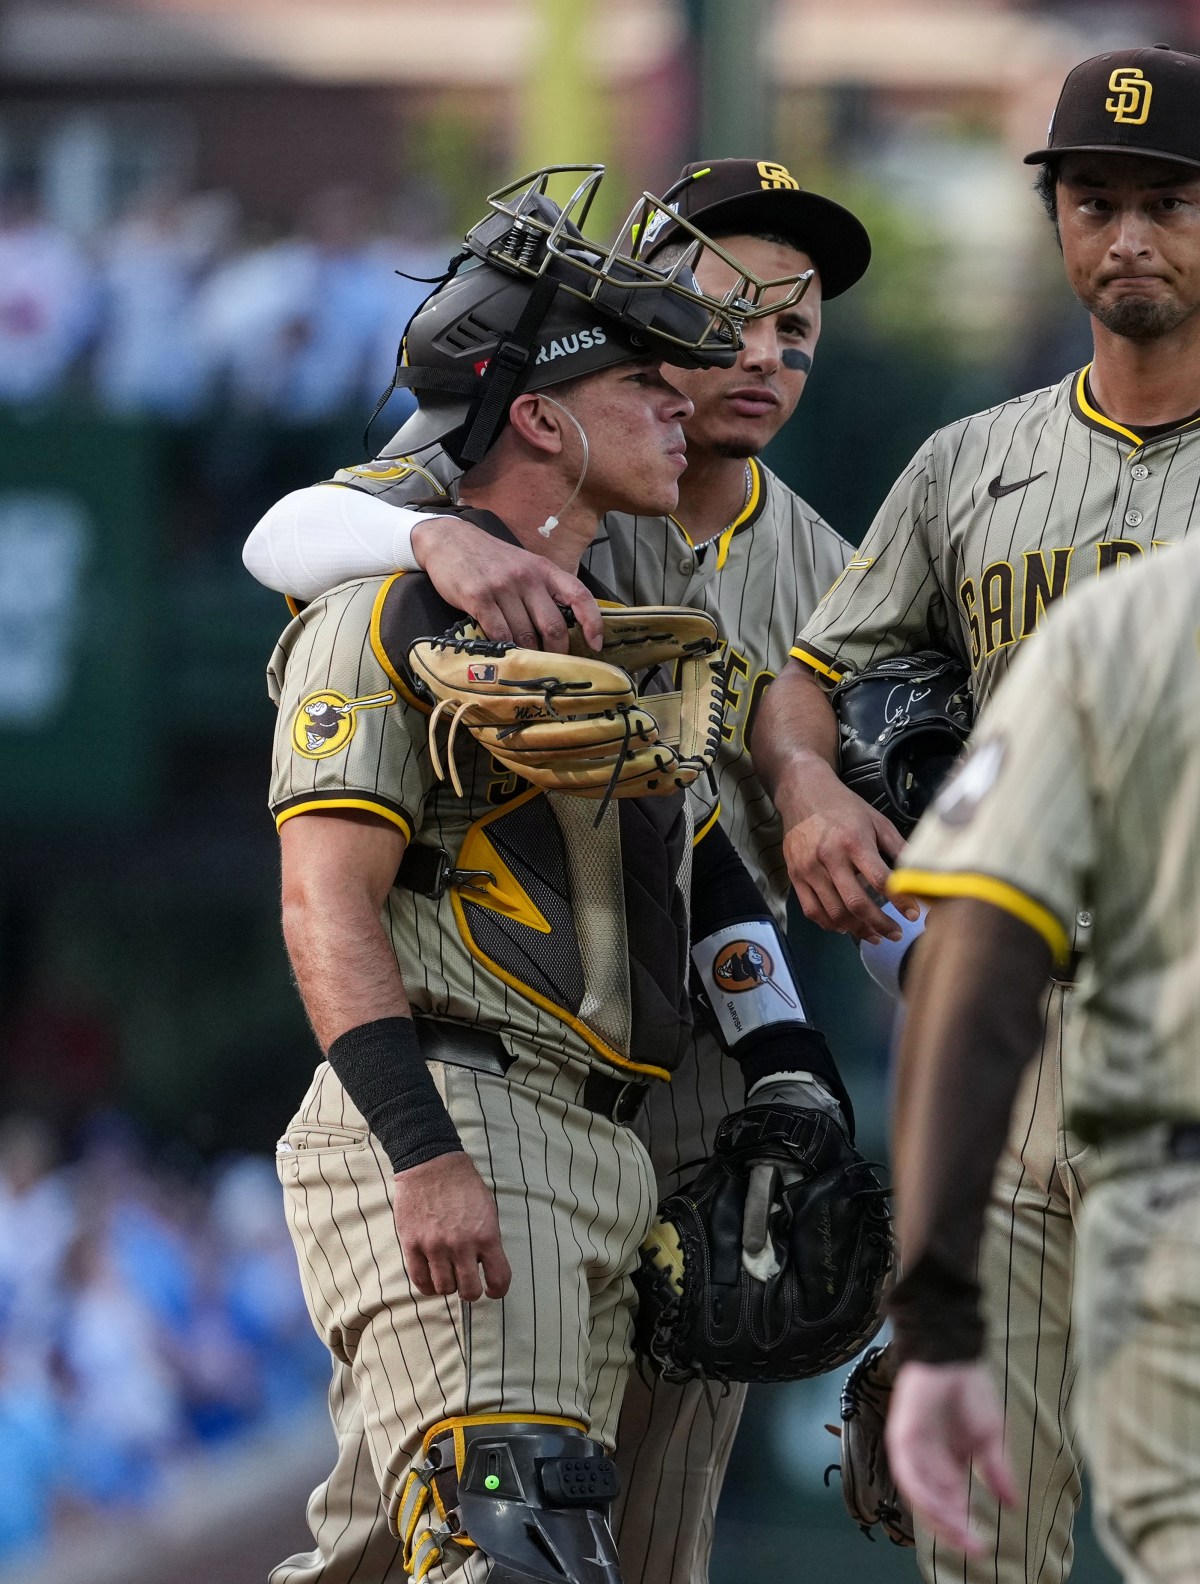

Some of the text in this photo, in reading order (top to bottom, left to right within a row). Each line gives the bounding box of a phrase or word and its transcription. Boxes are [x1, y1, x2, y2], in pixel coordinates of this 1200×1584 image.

[1105, 68, 1153, 125] SD
[535, 326, 607, 366] RAUSS
[960, 546, 1075, 671] SAN
[726, 1001, 744, 1033] DARVISH
